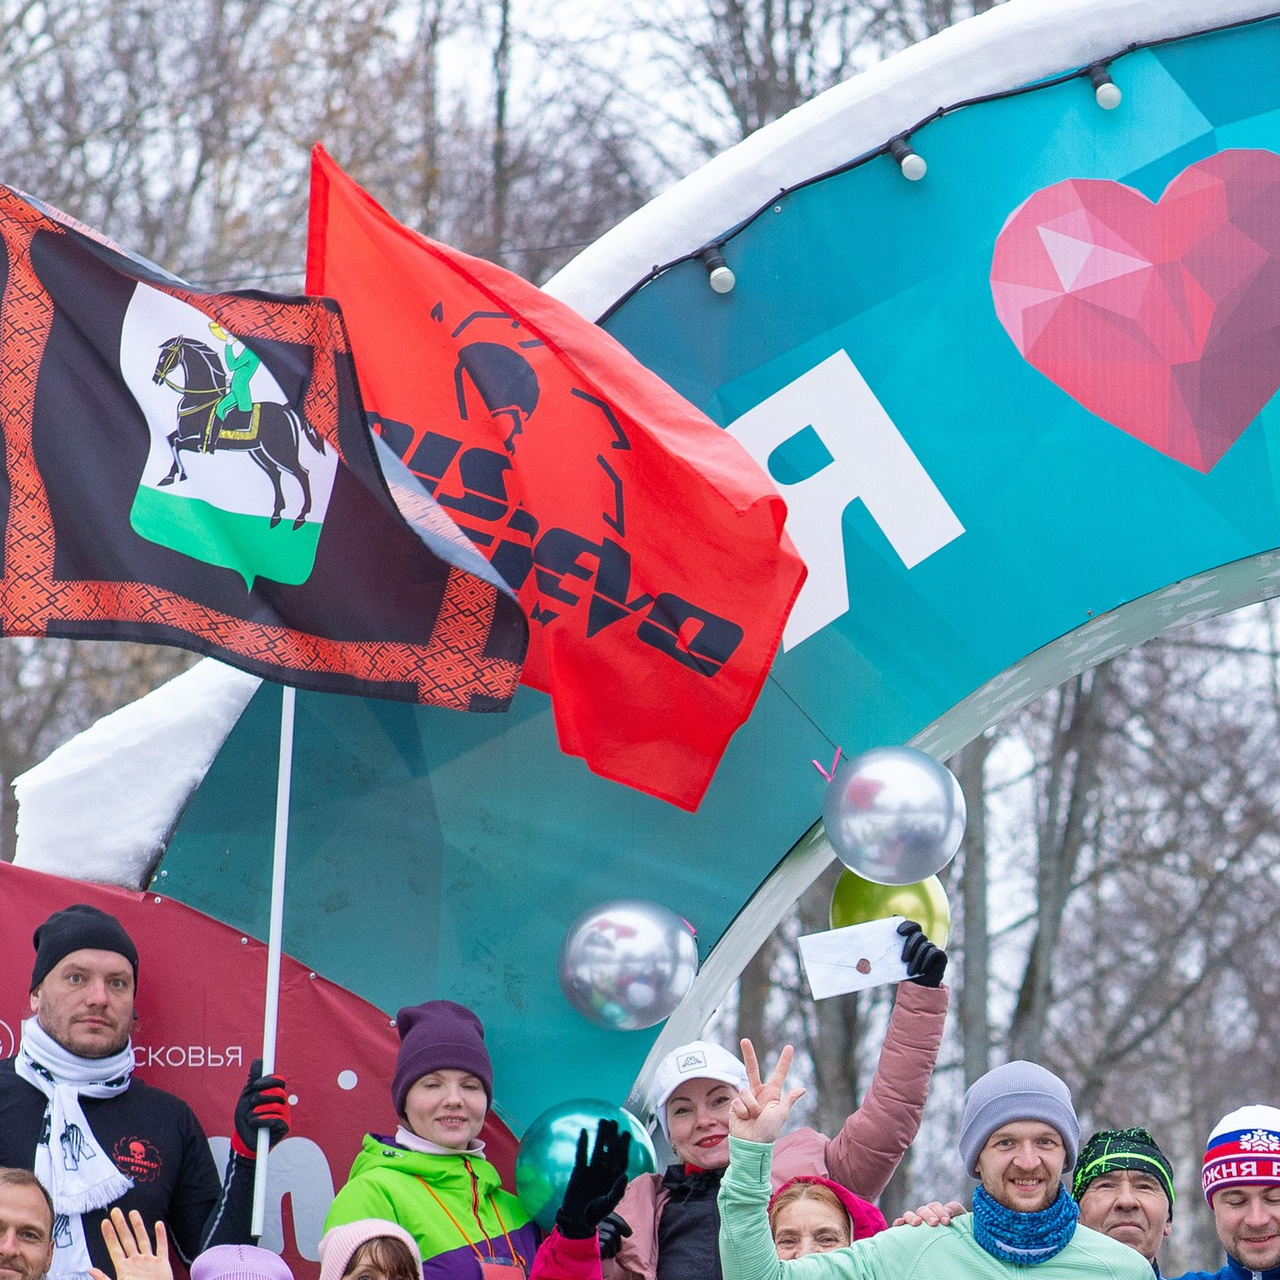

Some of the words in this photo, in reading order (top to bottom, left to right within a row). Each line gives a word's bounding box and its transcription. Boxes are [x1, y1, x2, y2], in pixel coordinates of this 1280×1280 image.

[723, 347, 967, 653] Я
[133, 1046, 242, 1067] СКОВЬЯ
[1203, 1161, 1258, 1190] ЖНЯ
